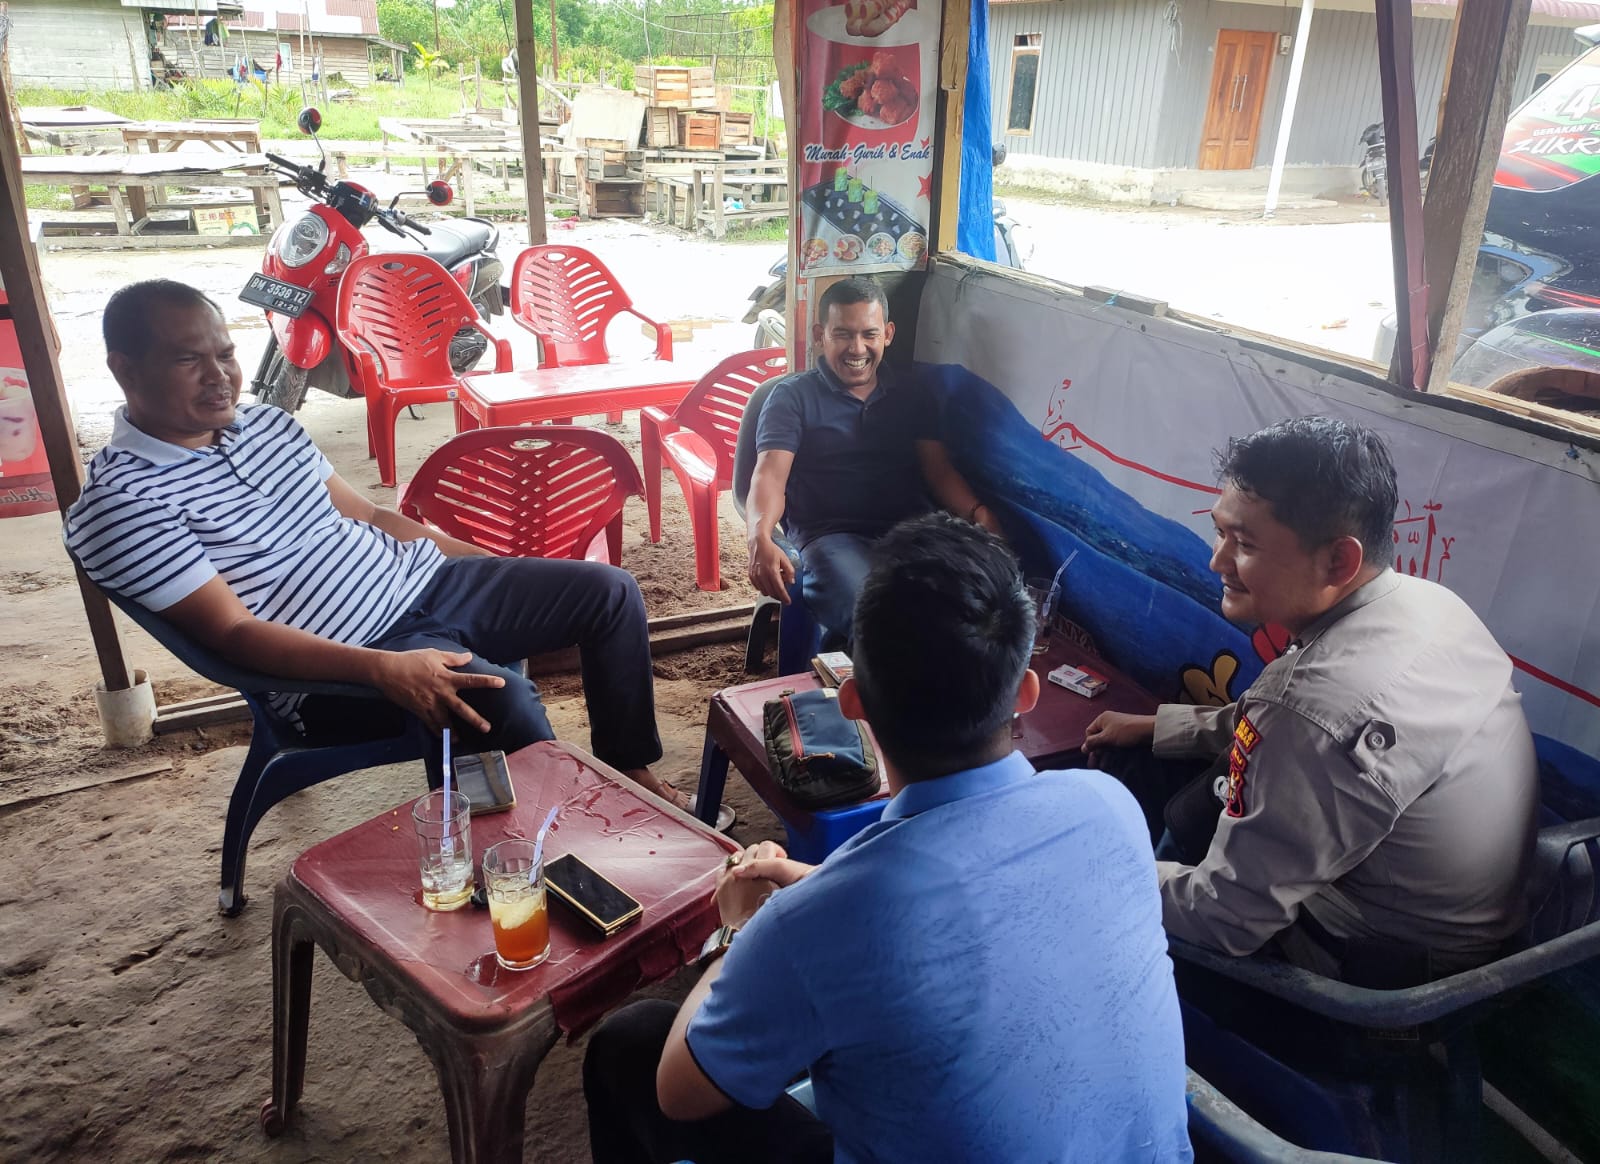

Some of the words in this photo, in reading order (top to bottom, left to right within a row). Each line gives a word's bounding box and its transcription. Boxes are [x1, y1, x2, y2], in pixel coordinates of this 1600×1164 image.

[888, 144, 898, 160] &
[900, 144, 930, 161] Enak
[1508, 136, 1600, 154] ZUKR
[251, 278, 266, 290] BM
